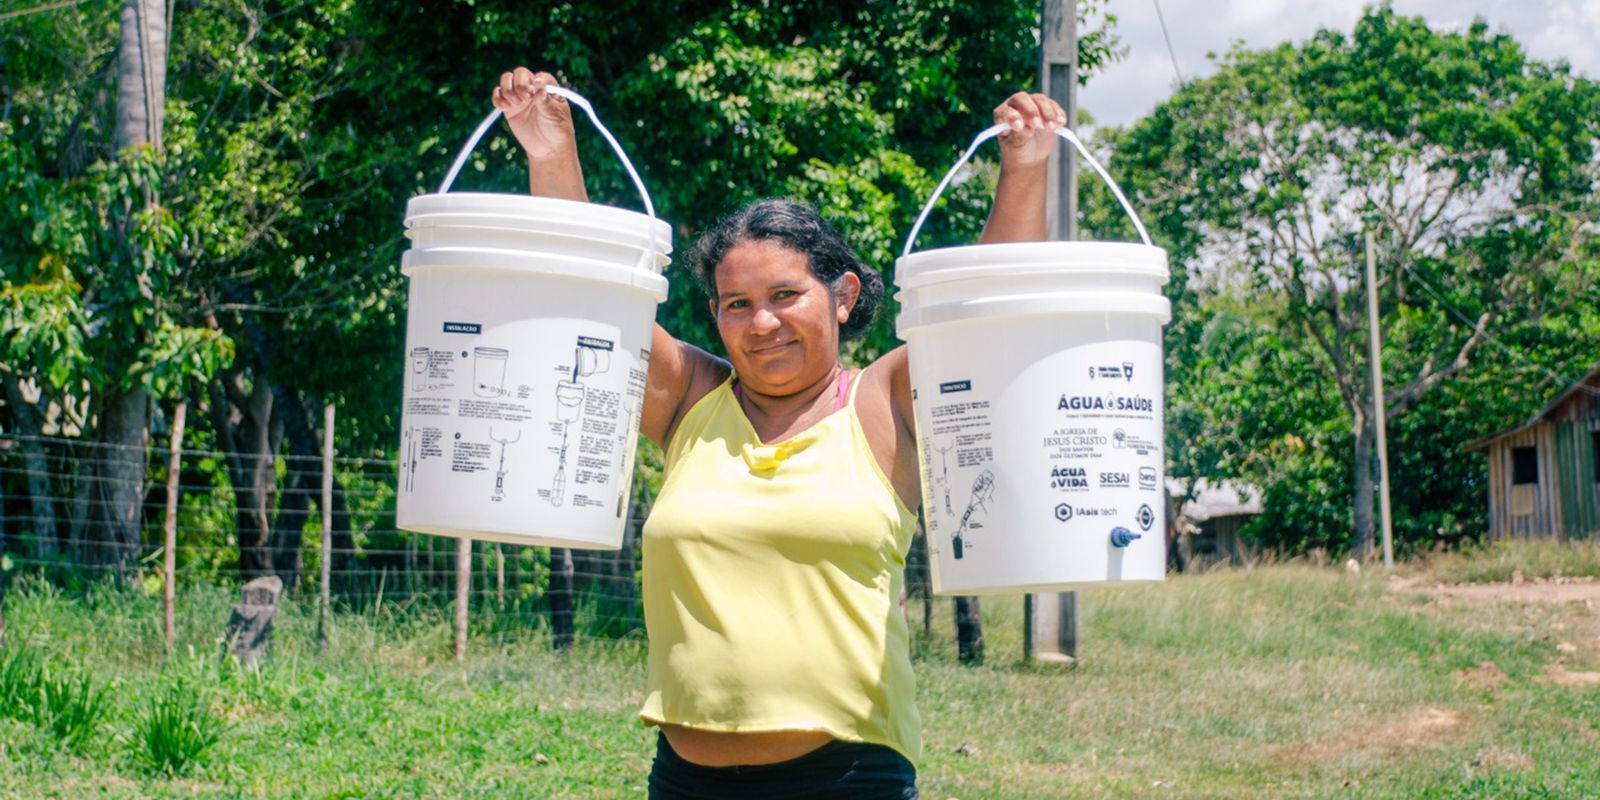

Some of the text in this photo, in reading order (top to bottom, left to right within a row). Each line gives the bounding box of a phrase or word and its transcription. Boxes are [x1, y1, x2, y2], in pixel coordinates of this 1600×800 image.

[1089, 366, 1095, 379] 6
[1058, 394, 1104, 410] ÁGUA
[1117, 394, 1152, 412] SAÚDE
[1044, 436, 1107, 447] JESUS CRISTO
[1051, 465, 1086, 477] ÁGUA
[1057, 478, 1088, 487] VIDA
[1100, 472, 1130, 483] SESAI
